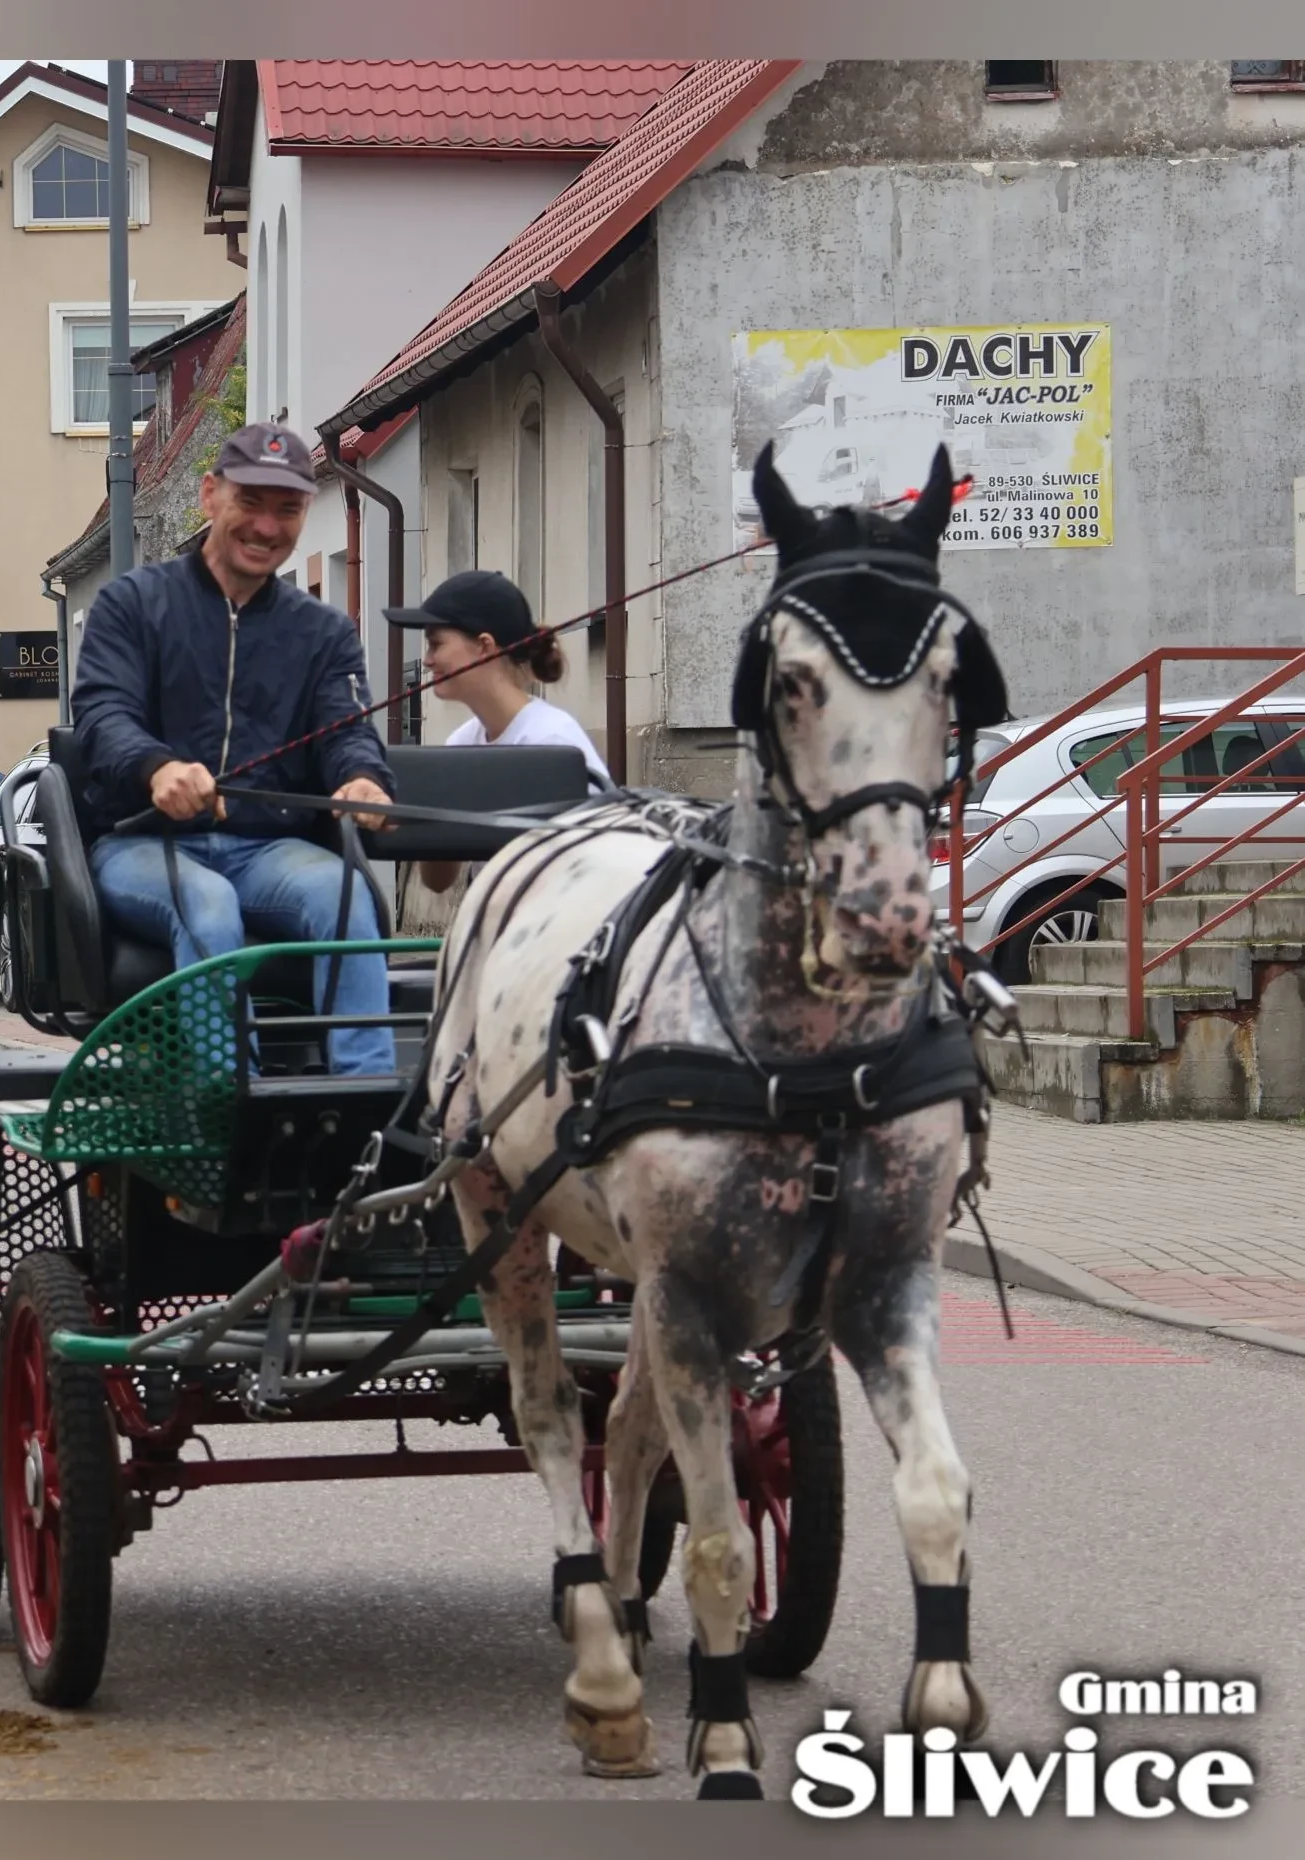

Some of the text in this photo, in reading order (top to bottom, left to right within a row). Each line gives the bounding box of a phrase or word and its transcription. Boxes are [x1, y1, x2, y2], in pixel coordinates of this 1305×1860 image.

[901, 332, 1099, 381] DACHY
[936, 394, 975, 406] FIRMA
[954, 411, 1084, 425] Jacek Kwiatkowski
[988, 473, 1100, 488] 89-530 ŚLIWICE
[987, 489, 1099, 502] ul. Malinowa 10
[951, 508, 973, 523] el.
[1013, 507, 1034, 521] 33
[1040, 507, 1062, 521] 40
[1066, 506, 1099, 520] 000
[990, 526, 1024, 540] 606
[1029, 525, 1061, 539] 937
[1066, 524, 1099, 538] 389
